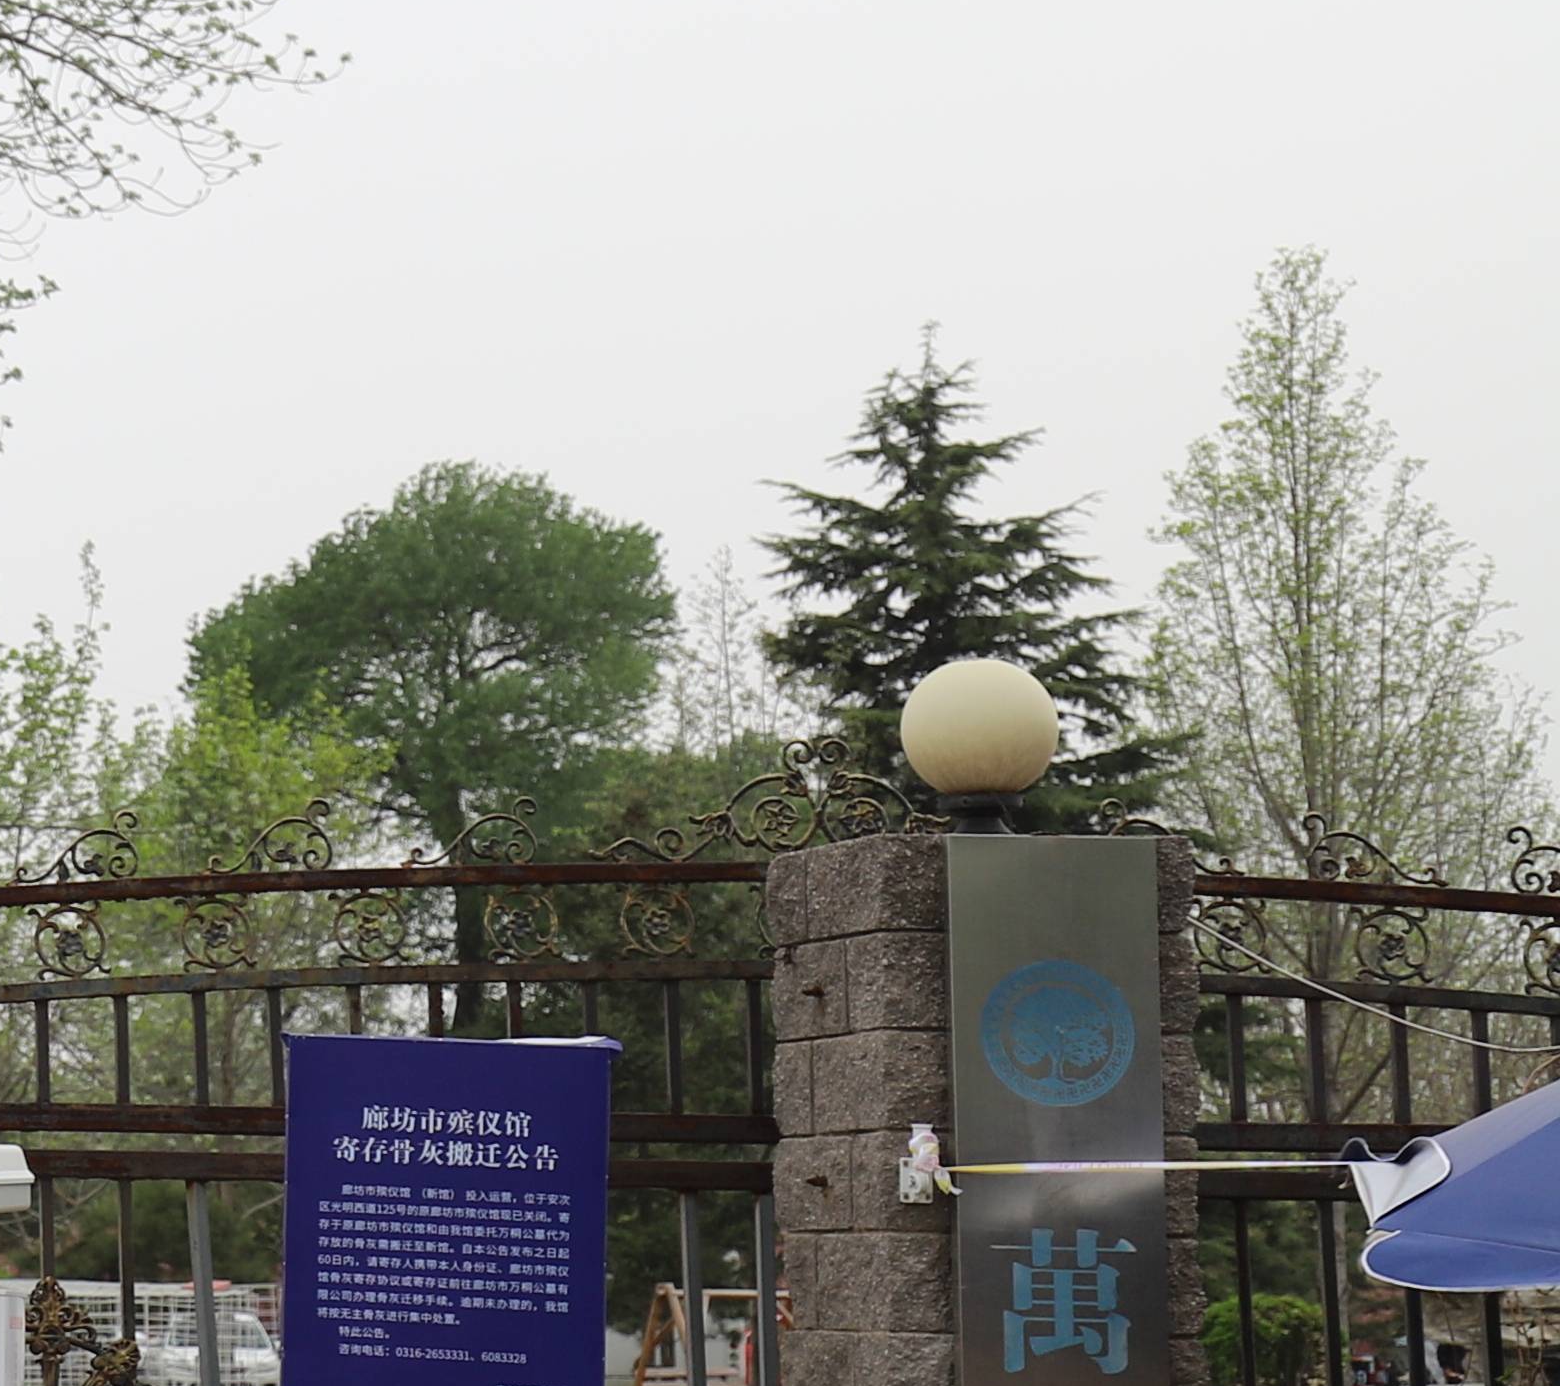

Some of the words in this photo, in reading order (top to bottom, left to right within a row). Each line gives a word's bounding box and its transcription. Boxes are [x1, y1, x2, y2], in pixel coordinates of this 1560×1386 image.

[361, 1104, 532, 1138] 廊坊市殡仪馆
[332, 1136, 559, 1171] 寄存骨灰搬迁公告
[318, 1218, 570, 1242] 存于原廊坊市殡仪馆和由我馆委托万桐公墓代为
[318, 1236, 570, 1260] 存放的骨灰需搬迁至新馆。自本公告发布之日起
[317, 1272, 569, 1295] 馆骨灰寄存协议或寄存证前往廊坊市万桐公墓有
[317, 1307, 462, 1326] 将按无主骨灰进行集中处置。
[338, 1326, 391, 1339] 特此公告。
